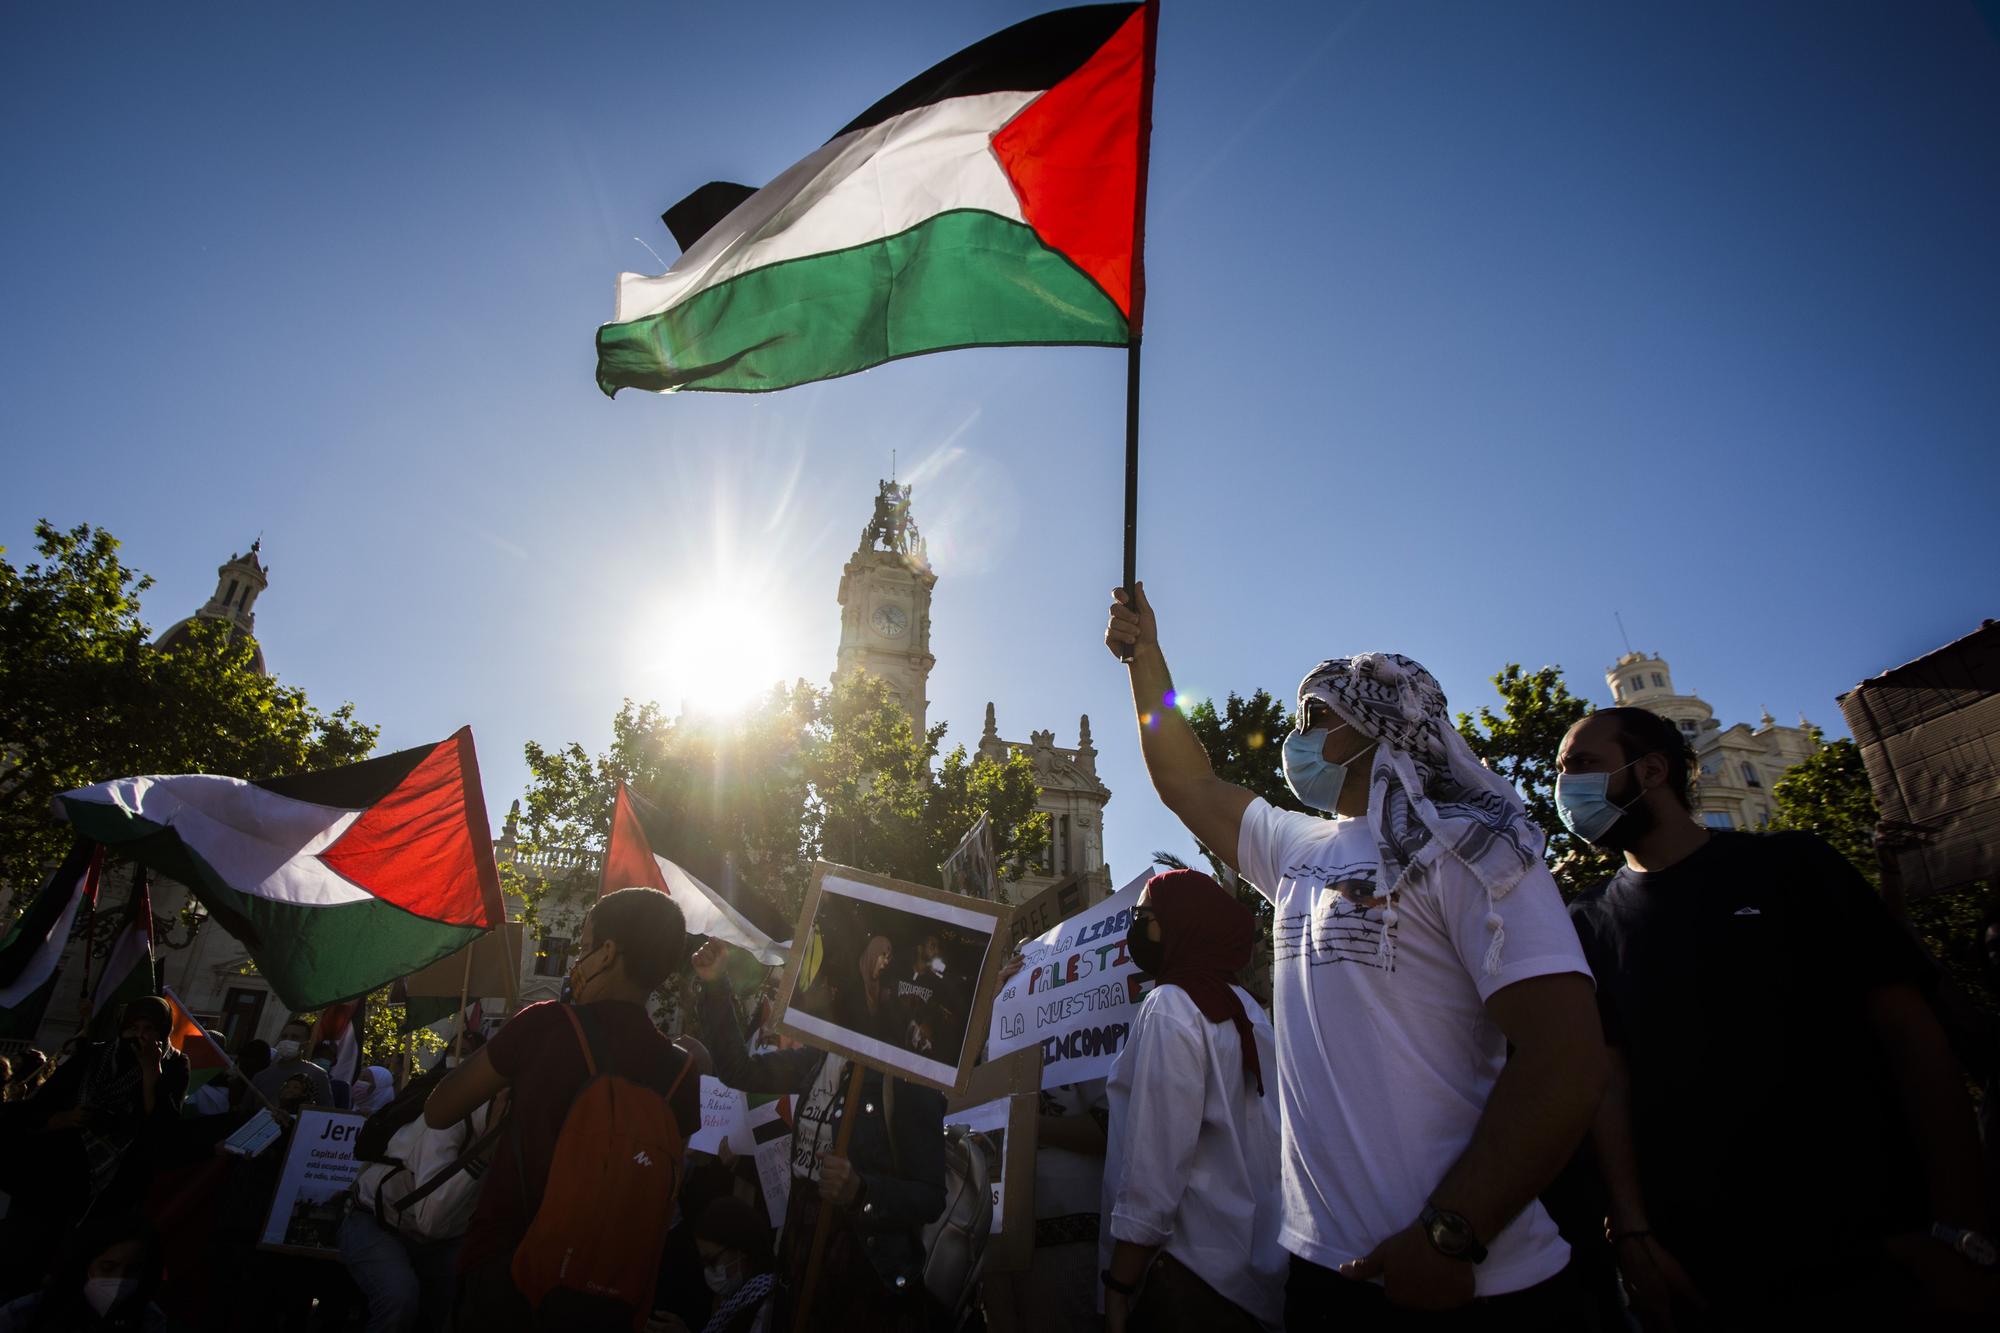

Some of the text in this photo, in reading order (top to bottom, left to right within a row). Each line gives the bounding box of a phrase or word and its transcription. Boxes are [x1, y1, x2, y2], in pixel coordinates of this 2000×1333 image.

[1002, 987, 1016, 1001] DE
[1028, 940, 1133, 995] PALESTI
[1000, 982, 1125, 1040] LA NUESTRA
[311, 1149, 351, 1160] Capital del
